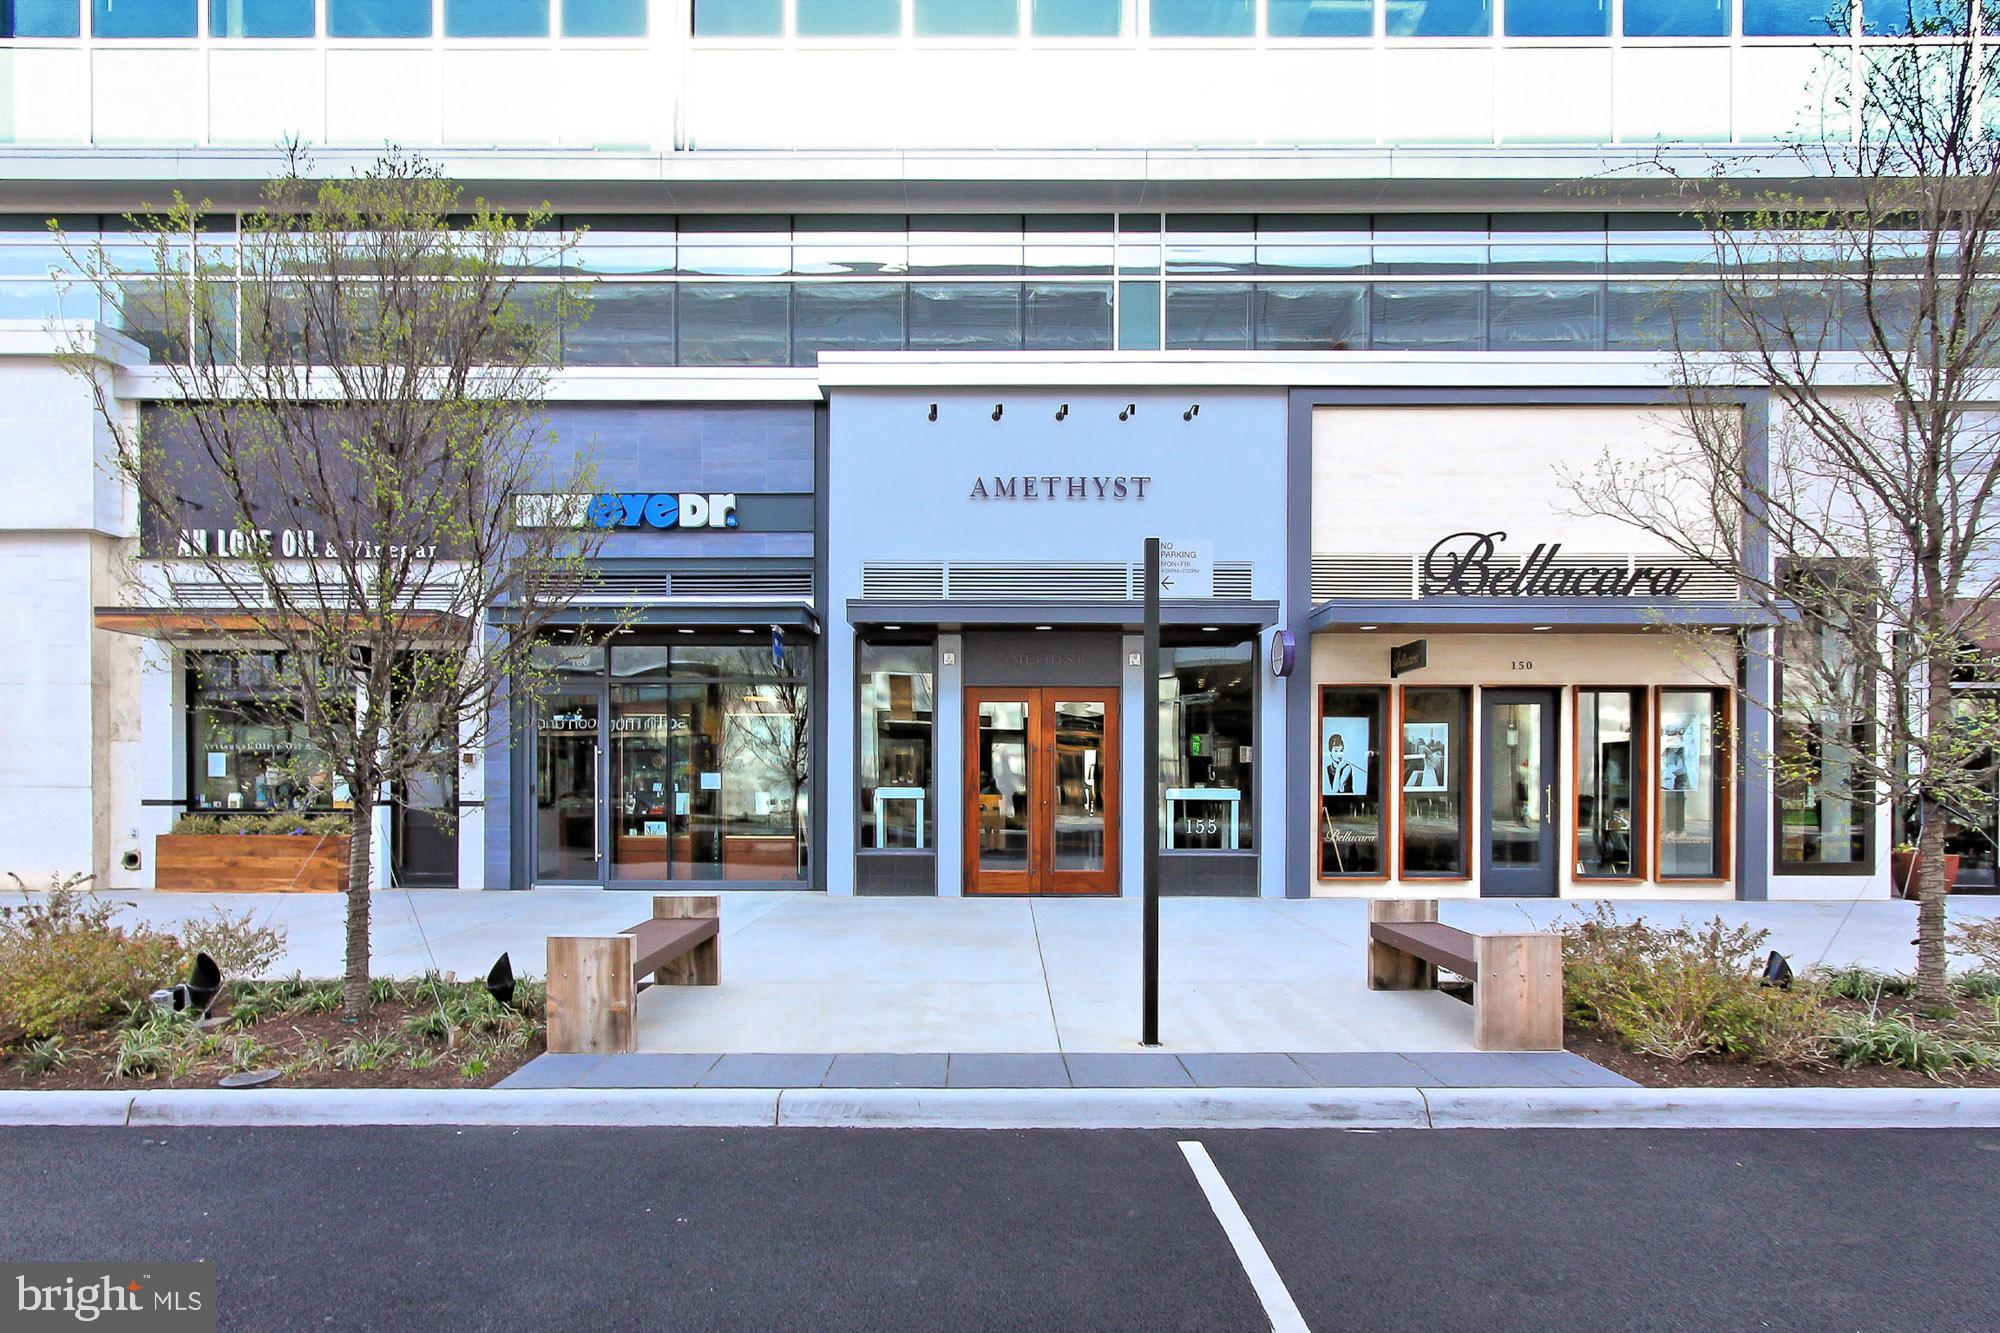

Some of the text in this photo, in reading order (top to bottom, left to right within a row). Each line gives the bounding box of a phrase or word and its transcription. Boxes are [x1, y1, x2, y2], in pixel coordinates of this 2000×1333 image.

[969, 476, 1151, 499] AMETHYST
[281, 528, 320, 558] OIL
[324, 541, 338, 559] &
[1160, 542, 1174, 550] NO
[1160, 551, 1197, 559] PARKING
[1420, 531, 1692, 597] Bellacara
[1511, 661, 1533, 670] 150
[1186, 819, 1217, 834] 155
[1324, 828, 1376, 843] Bellacara
